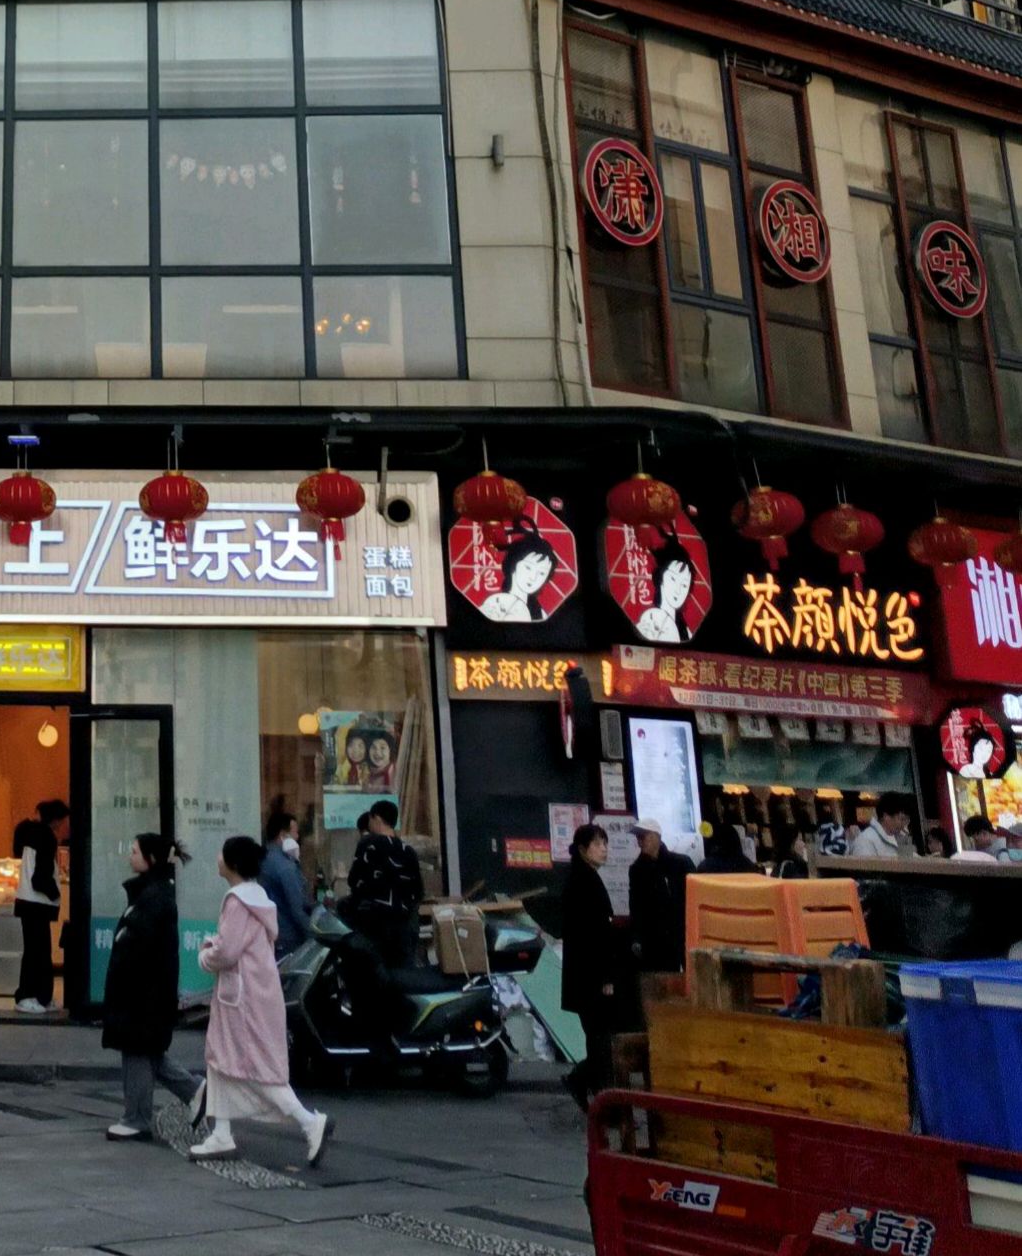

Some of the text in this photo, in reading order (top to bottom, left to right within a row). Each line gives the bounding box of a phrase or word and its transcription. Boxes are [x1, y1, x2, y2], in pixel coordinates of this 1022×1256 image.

[600, 159, 979, 303] 潇 湘 味
[124, 516, 319, 581] 鲜乐达
[364, 546, 414, 569] 蛋糕
[365, 574, 415, 598] 面包
[743, 573, 924, 661] 茶颜悦色
[966, 556, 1022, 649] 湘
[469, 656, 567, 691] 茶颜悦色
